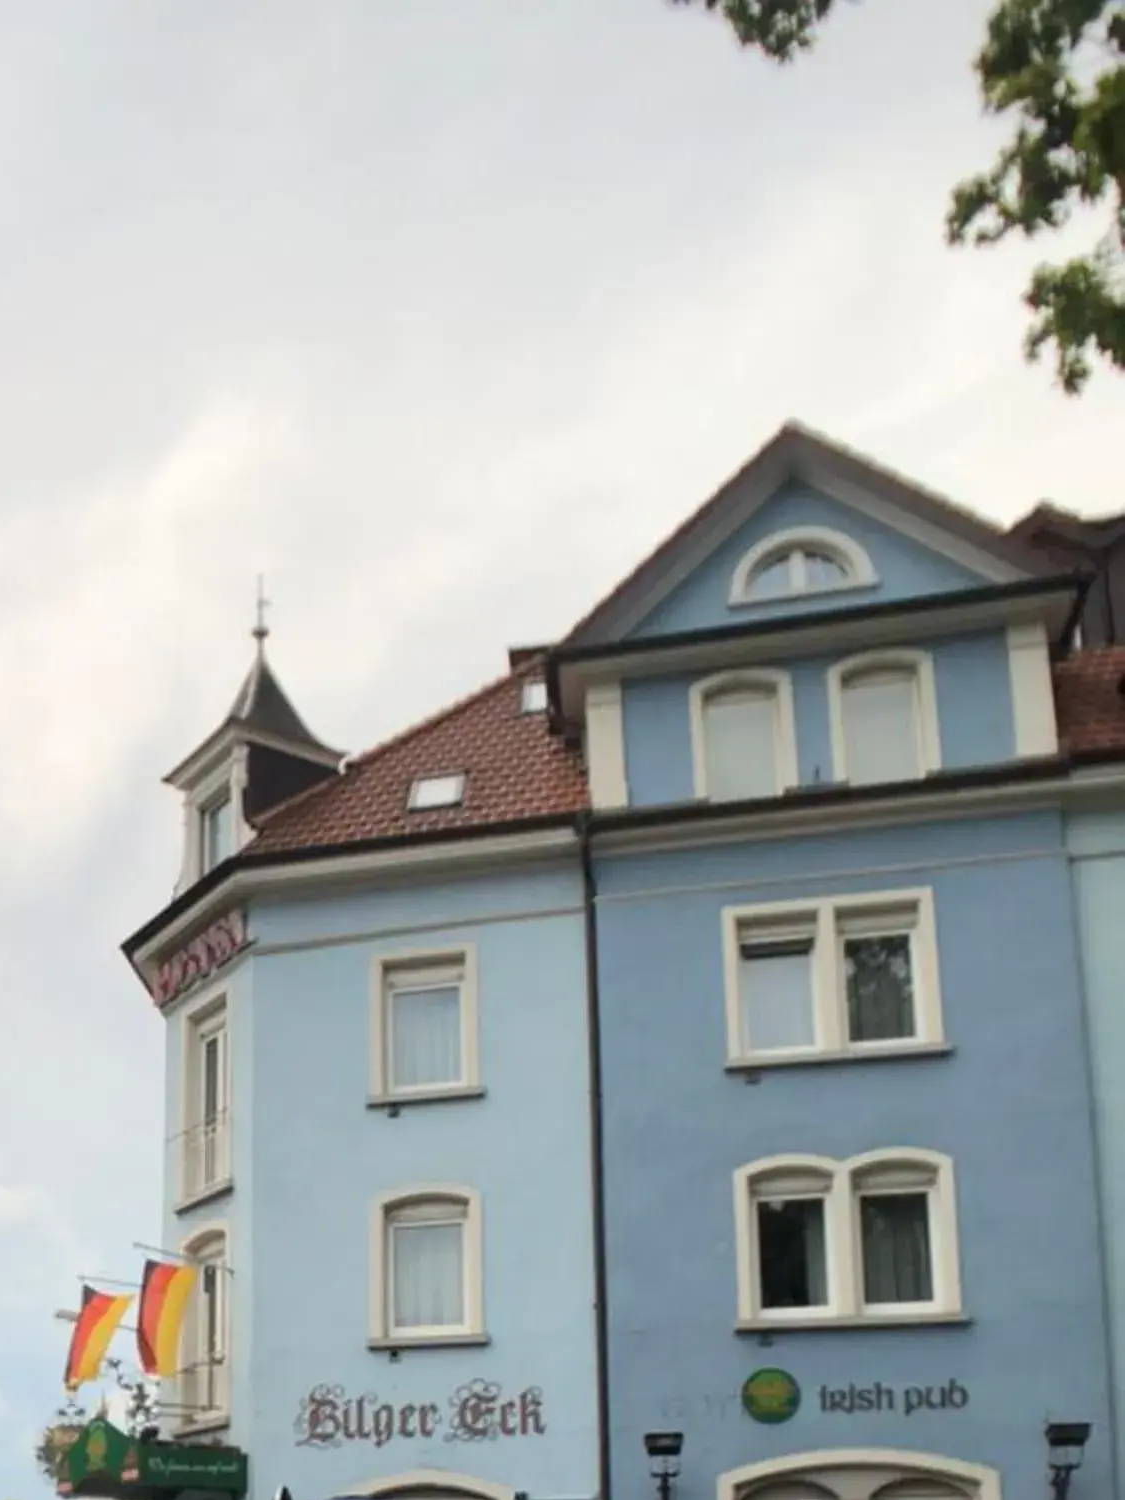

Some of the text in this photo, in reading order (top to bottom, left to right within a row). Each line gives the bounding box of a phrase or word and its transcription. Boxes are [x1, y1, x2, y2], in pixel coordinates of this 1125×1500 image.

[295, 1378, 547, 1449] Bilger Eck
[904, 1378, 971, 1416] pub
